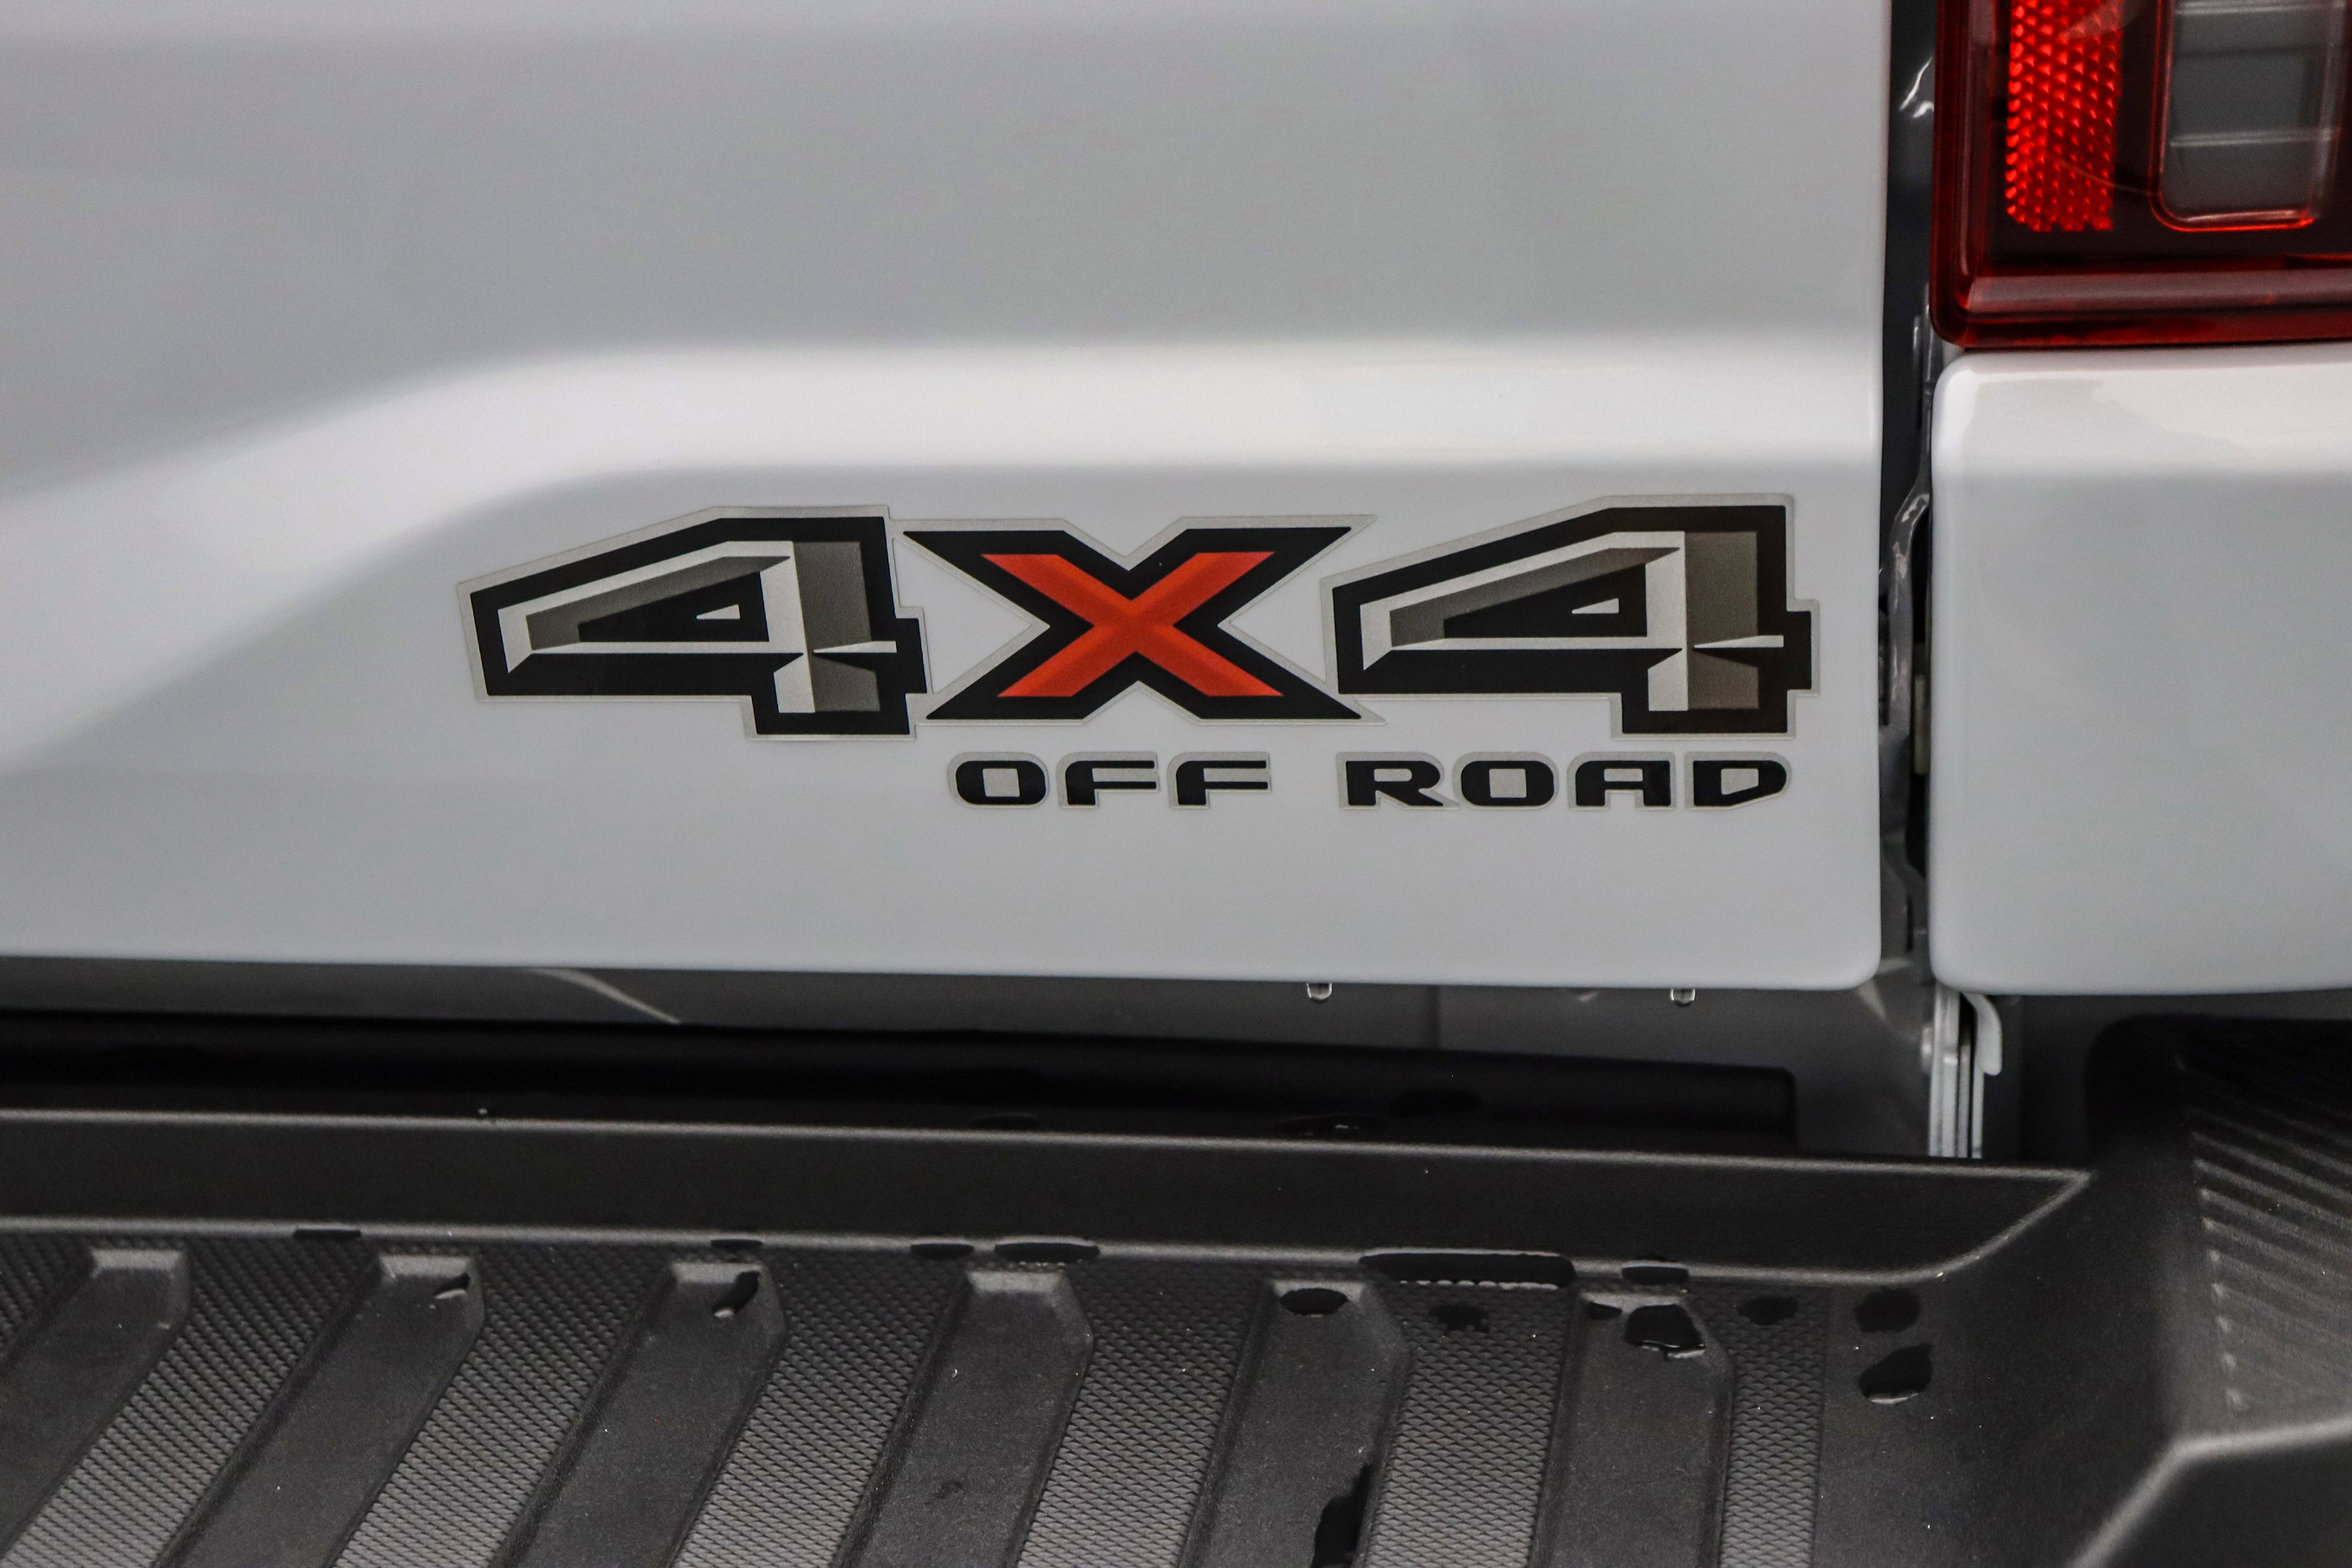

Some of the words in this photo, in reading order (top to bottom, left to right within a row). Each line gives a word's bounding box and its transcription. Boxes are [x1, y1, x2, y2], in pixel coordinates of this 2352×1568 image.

[470, 505, 1812, 735] 4X4
[955, 760, 1268, 806] OFF
[1345, 760, 1787, 807] ROAD
